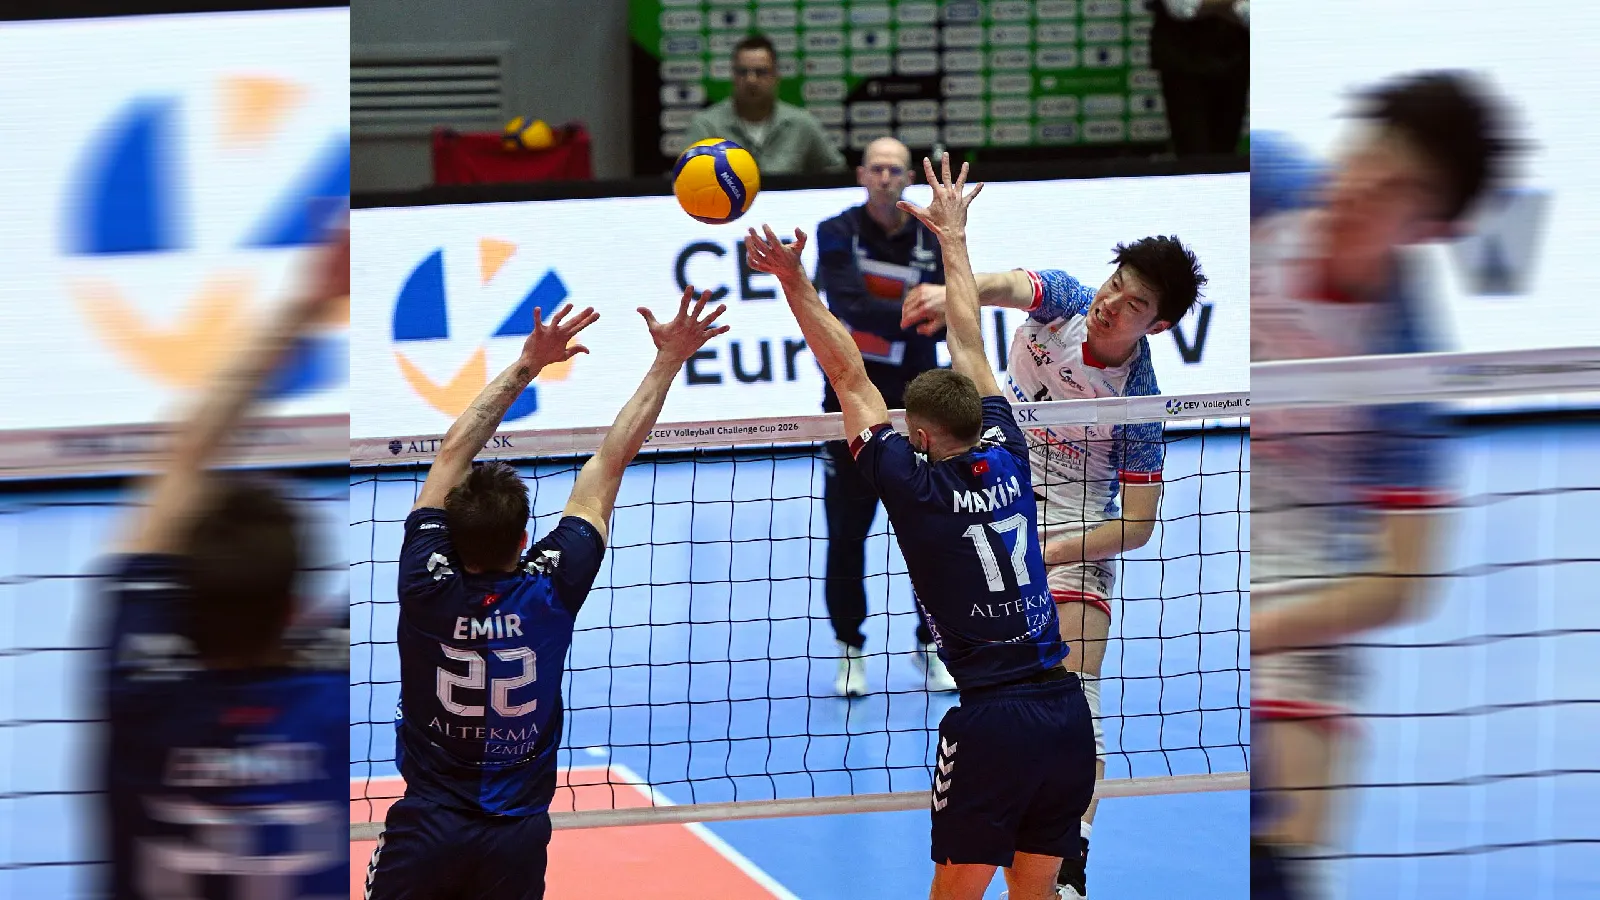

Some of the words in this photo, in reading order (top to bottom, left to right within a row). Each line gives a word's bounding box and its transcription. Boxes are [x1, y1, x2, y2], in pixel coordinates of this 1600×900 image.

[1183, 401, 1200, 410] CEV
[1202, 398, 1243, 410] Volleyball
[1018, 408, 1040, 423] SK
[654, 429, 671, 438] CEV
[674, 427, 715, 438] Volleyball
[717, 424, 757, 436] Challenge
[759, 424, 776, 434] Cup
[778, 422, 799, 432] 2026
[493, 435, 514, 449] SK
[962, 513, 1031, 592] 17
[436, 643, 537, 717] 22
[428, 716, 539, 741] ALTEKMA
